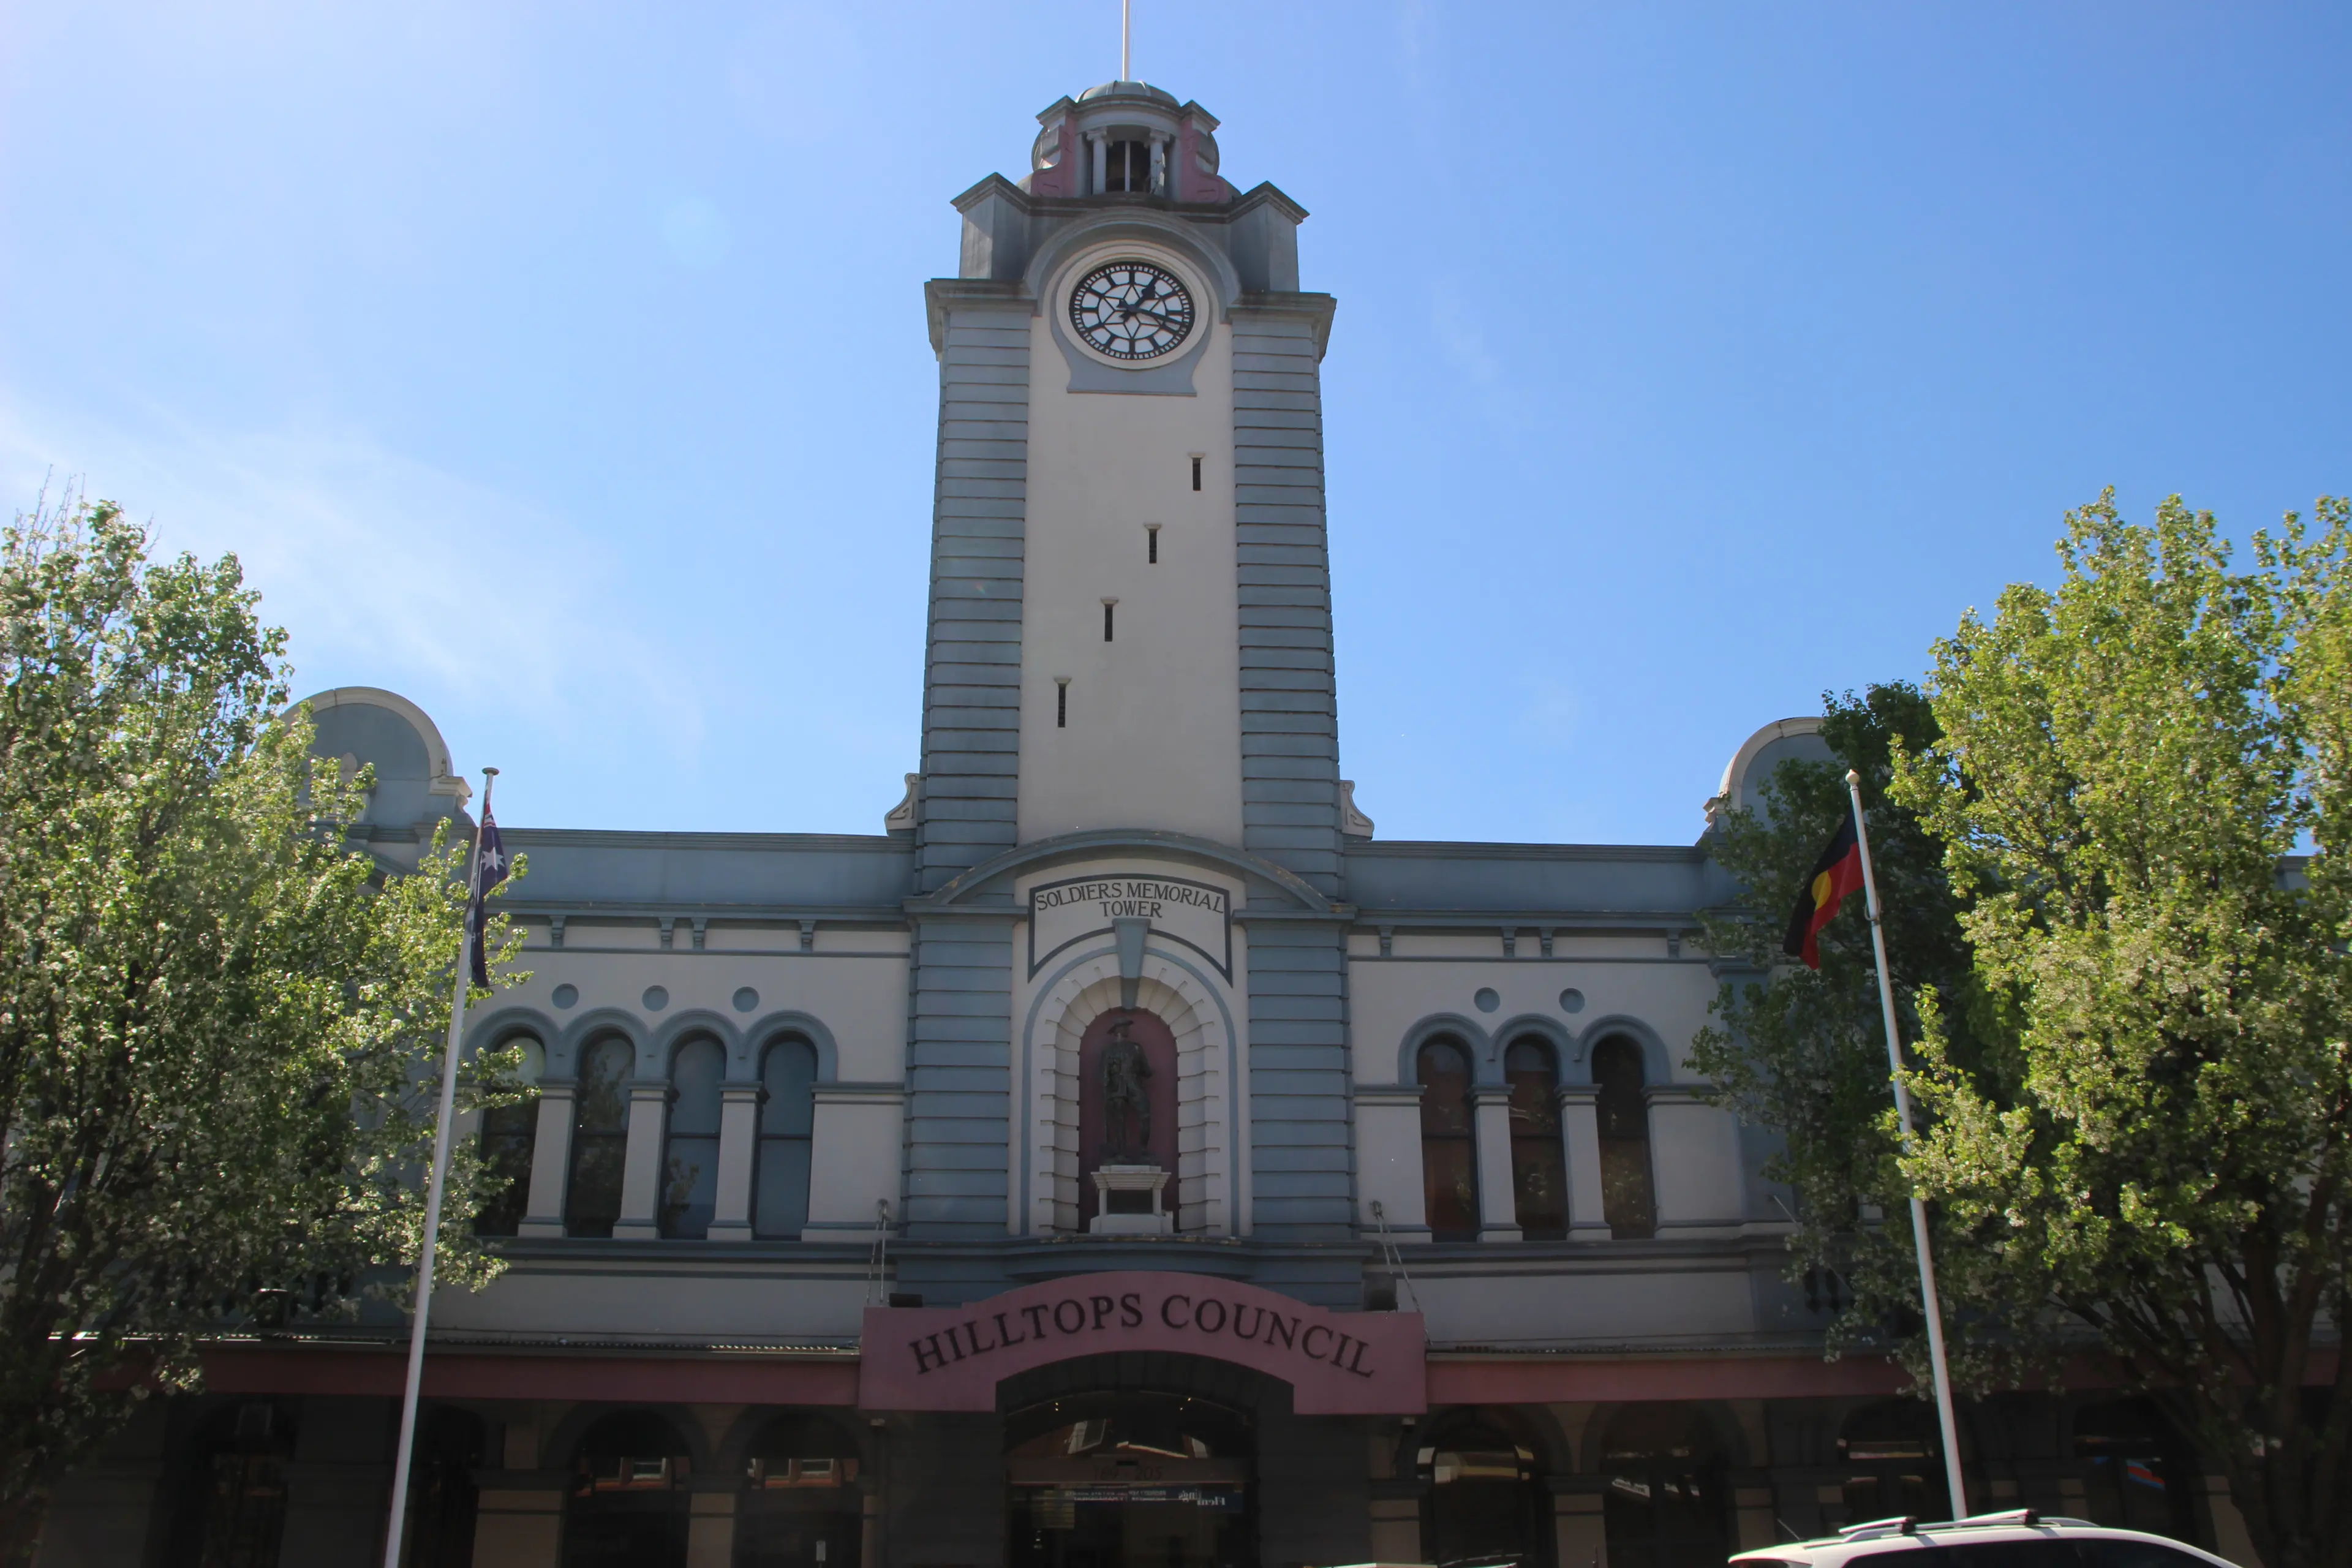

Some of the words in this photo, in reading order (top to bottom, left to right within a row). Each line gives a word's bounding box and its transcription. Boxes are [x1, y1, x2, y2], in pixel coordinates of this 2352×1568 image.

[1036, 882, 1123, 911] SOLDIERS
[1126, 883, 1224, 913] MEMORIAL
[1099, 901, 1163, 918] TOWER
[908, 1293, 1143, 1374] HILLTOPS
[1161, 1294, 1375, 1378] COUNCIL
